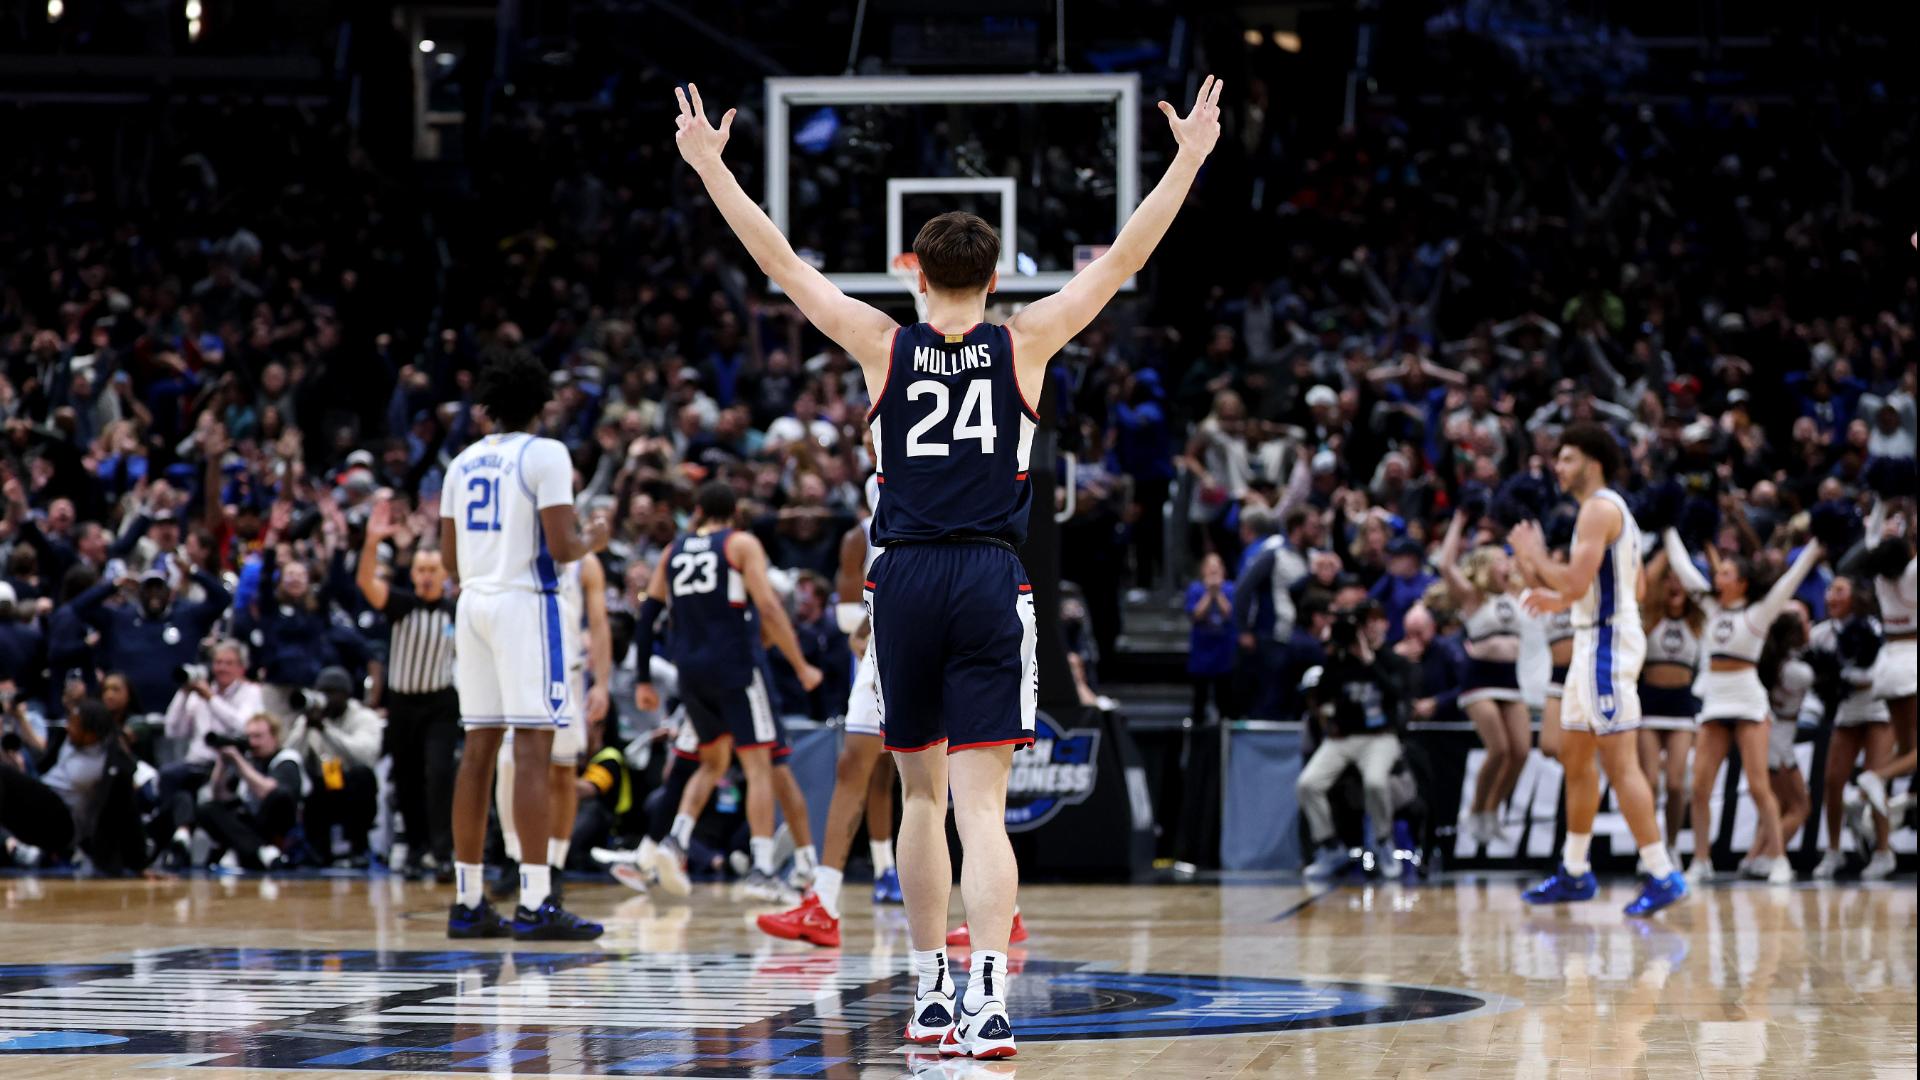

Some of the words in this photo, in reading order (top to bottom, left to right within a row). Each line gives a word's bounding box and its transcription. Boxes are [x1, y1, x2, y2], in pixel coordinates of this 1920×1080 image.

[914, 344, 991, 375] MULLINS
[906, 379, 997, 457] 24
[466, 477, 501, 531] 21
[671, 551, 718, 597] 23
